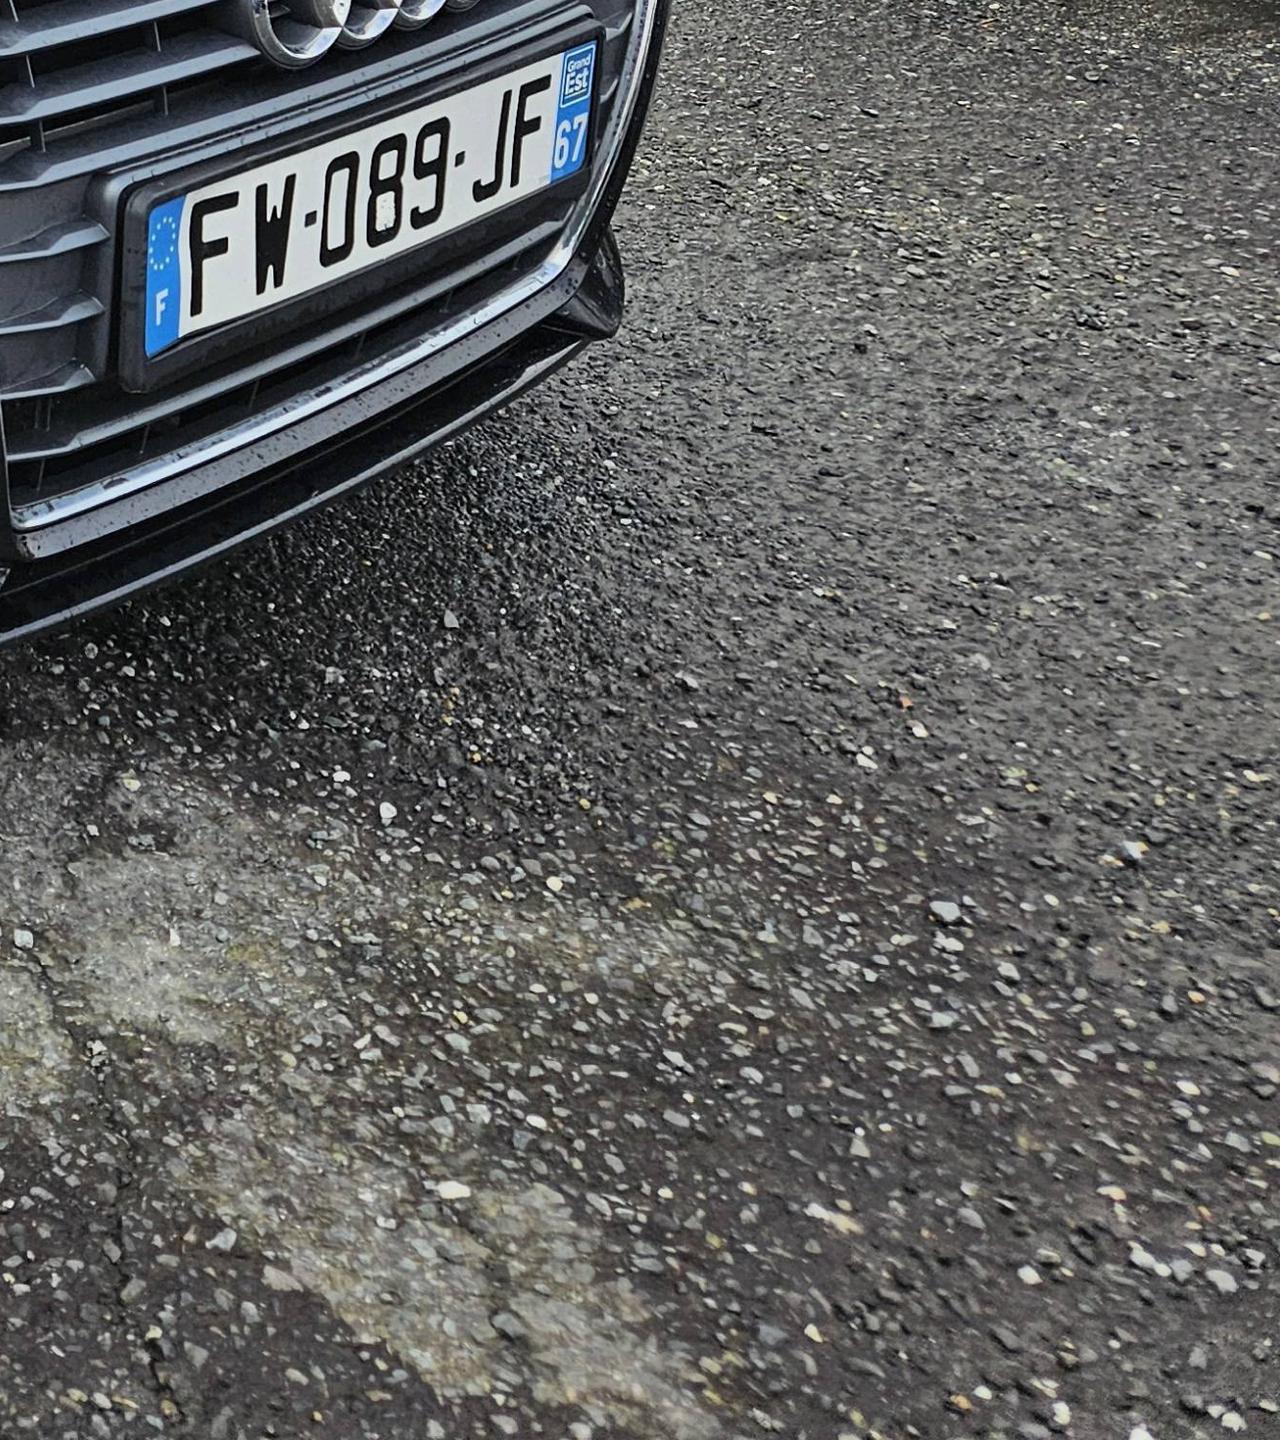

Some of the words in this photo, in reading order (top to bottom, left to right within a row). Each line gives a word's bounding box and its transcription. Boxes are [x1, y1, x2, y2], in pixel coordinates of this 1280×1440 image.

[565, 68, 590, 96] Est
[567, 53, 591, 72] Grand
[553, 111, 590, 170] 67
[188, 73, 552, 318] FW-089-JF
[155, 287, 169, 327] F
